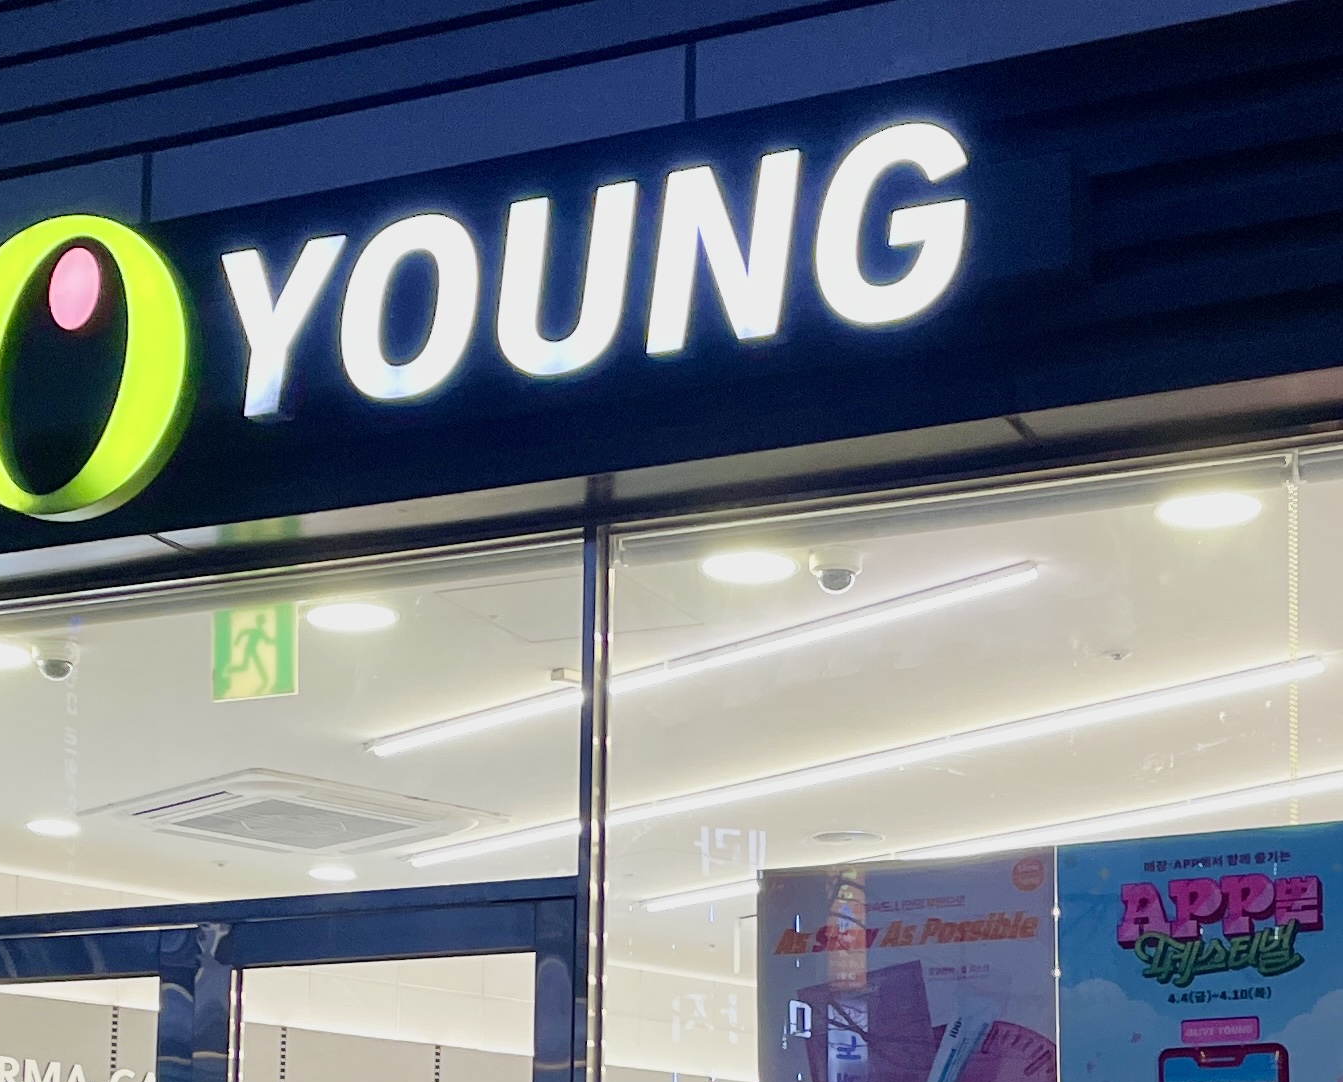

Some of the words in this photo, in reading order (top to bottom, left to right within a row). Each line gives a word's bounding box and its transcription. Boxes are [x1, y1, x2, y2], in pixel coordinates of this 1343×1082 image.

[222, 118, 972, 422] YOUNG
[878, 919, 920, 948] As
[918, 910, 1040, 945] Possible
[1134, 918, 1306, 988] 페스티벌
